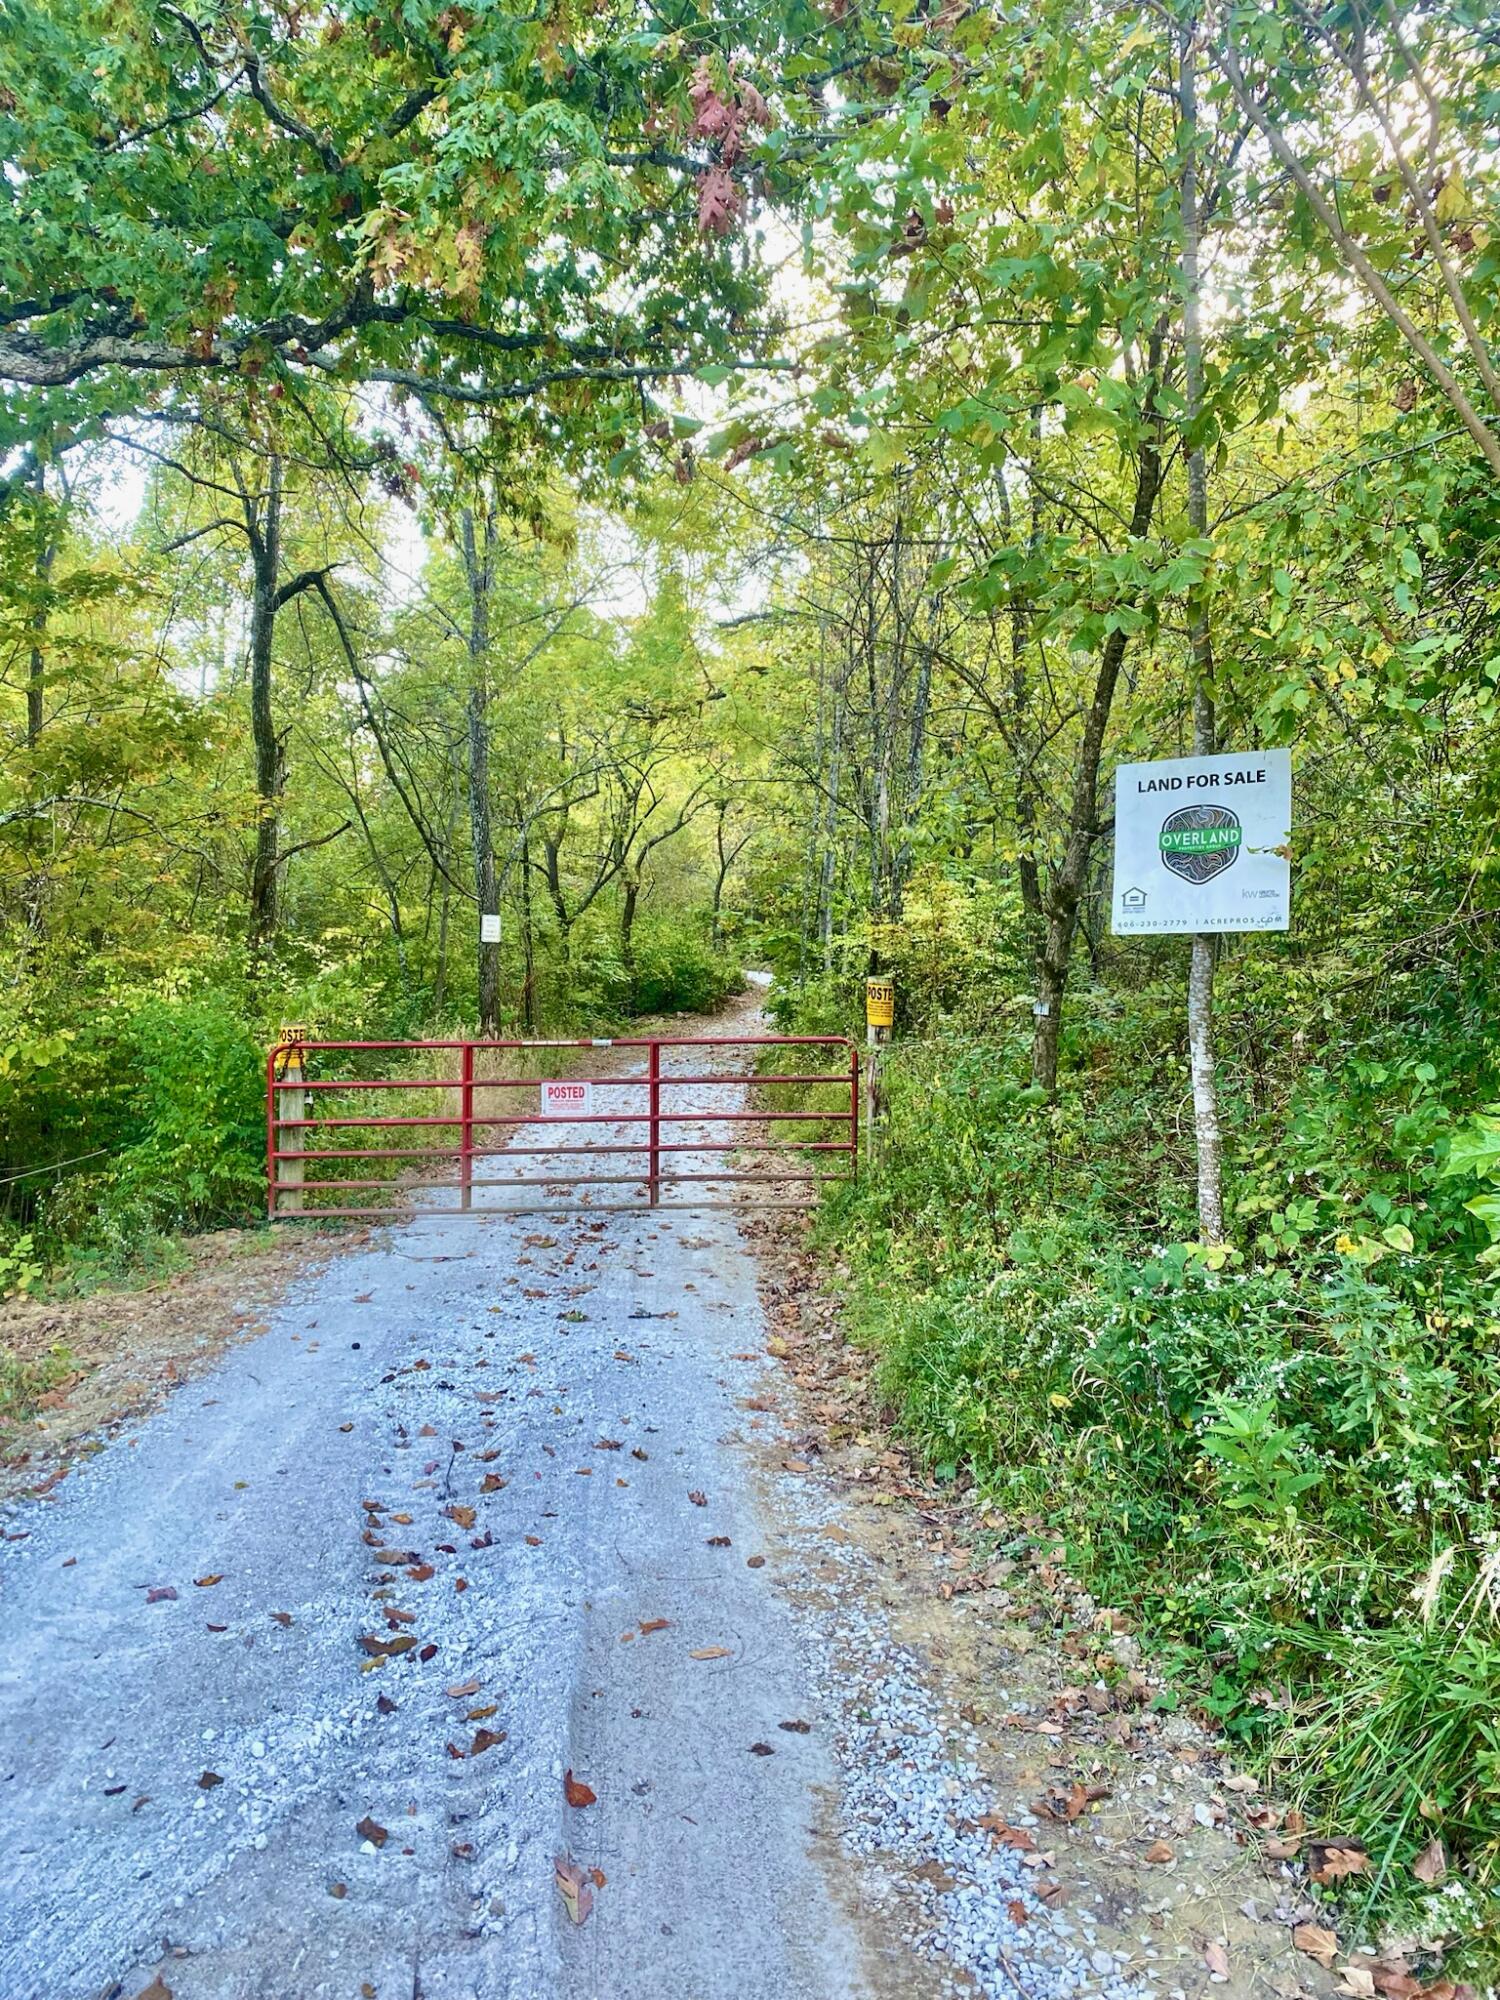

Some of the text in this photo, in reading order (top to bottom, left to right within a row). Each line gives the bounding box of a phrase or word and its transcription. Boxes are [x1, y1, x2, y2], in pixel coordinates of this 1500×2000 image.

[1138, 769, 1266, 793] LAND FOR SALE
[1161, 829, 1240, 847] OVERLAND
[547, 1086, 585, 1099] POSTED
